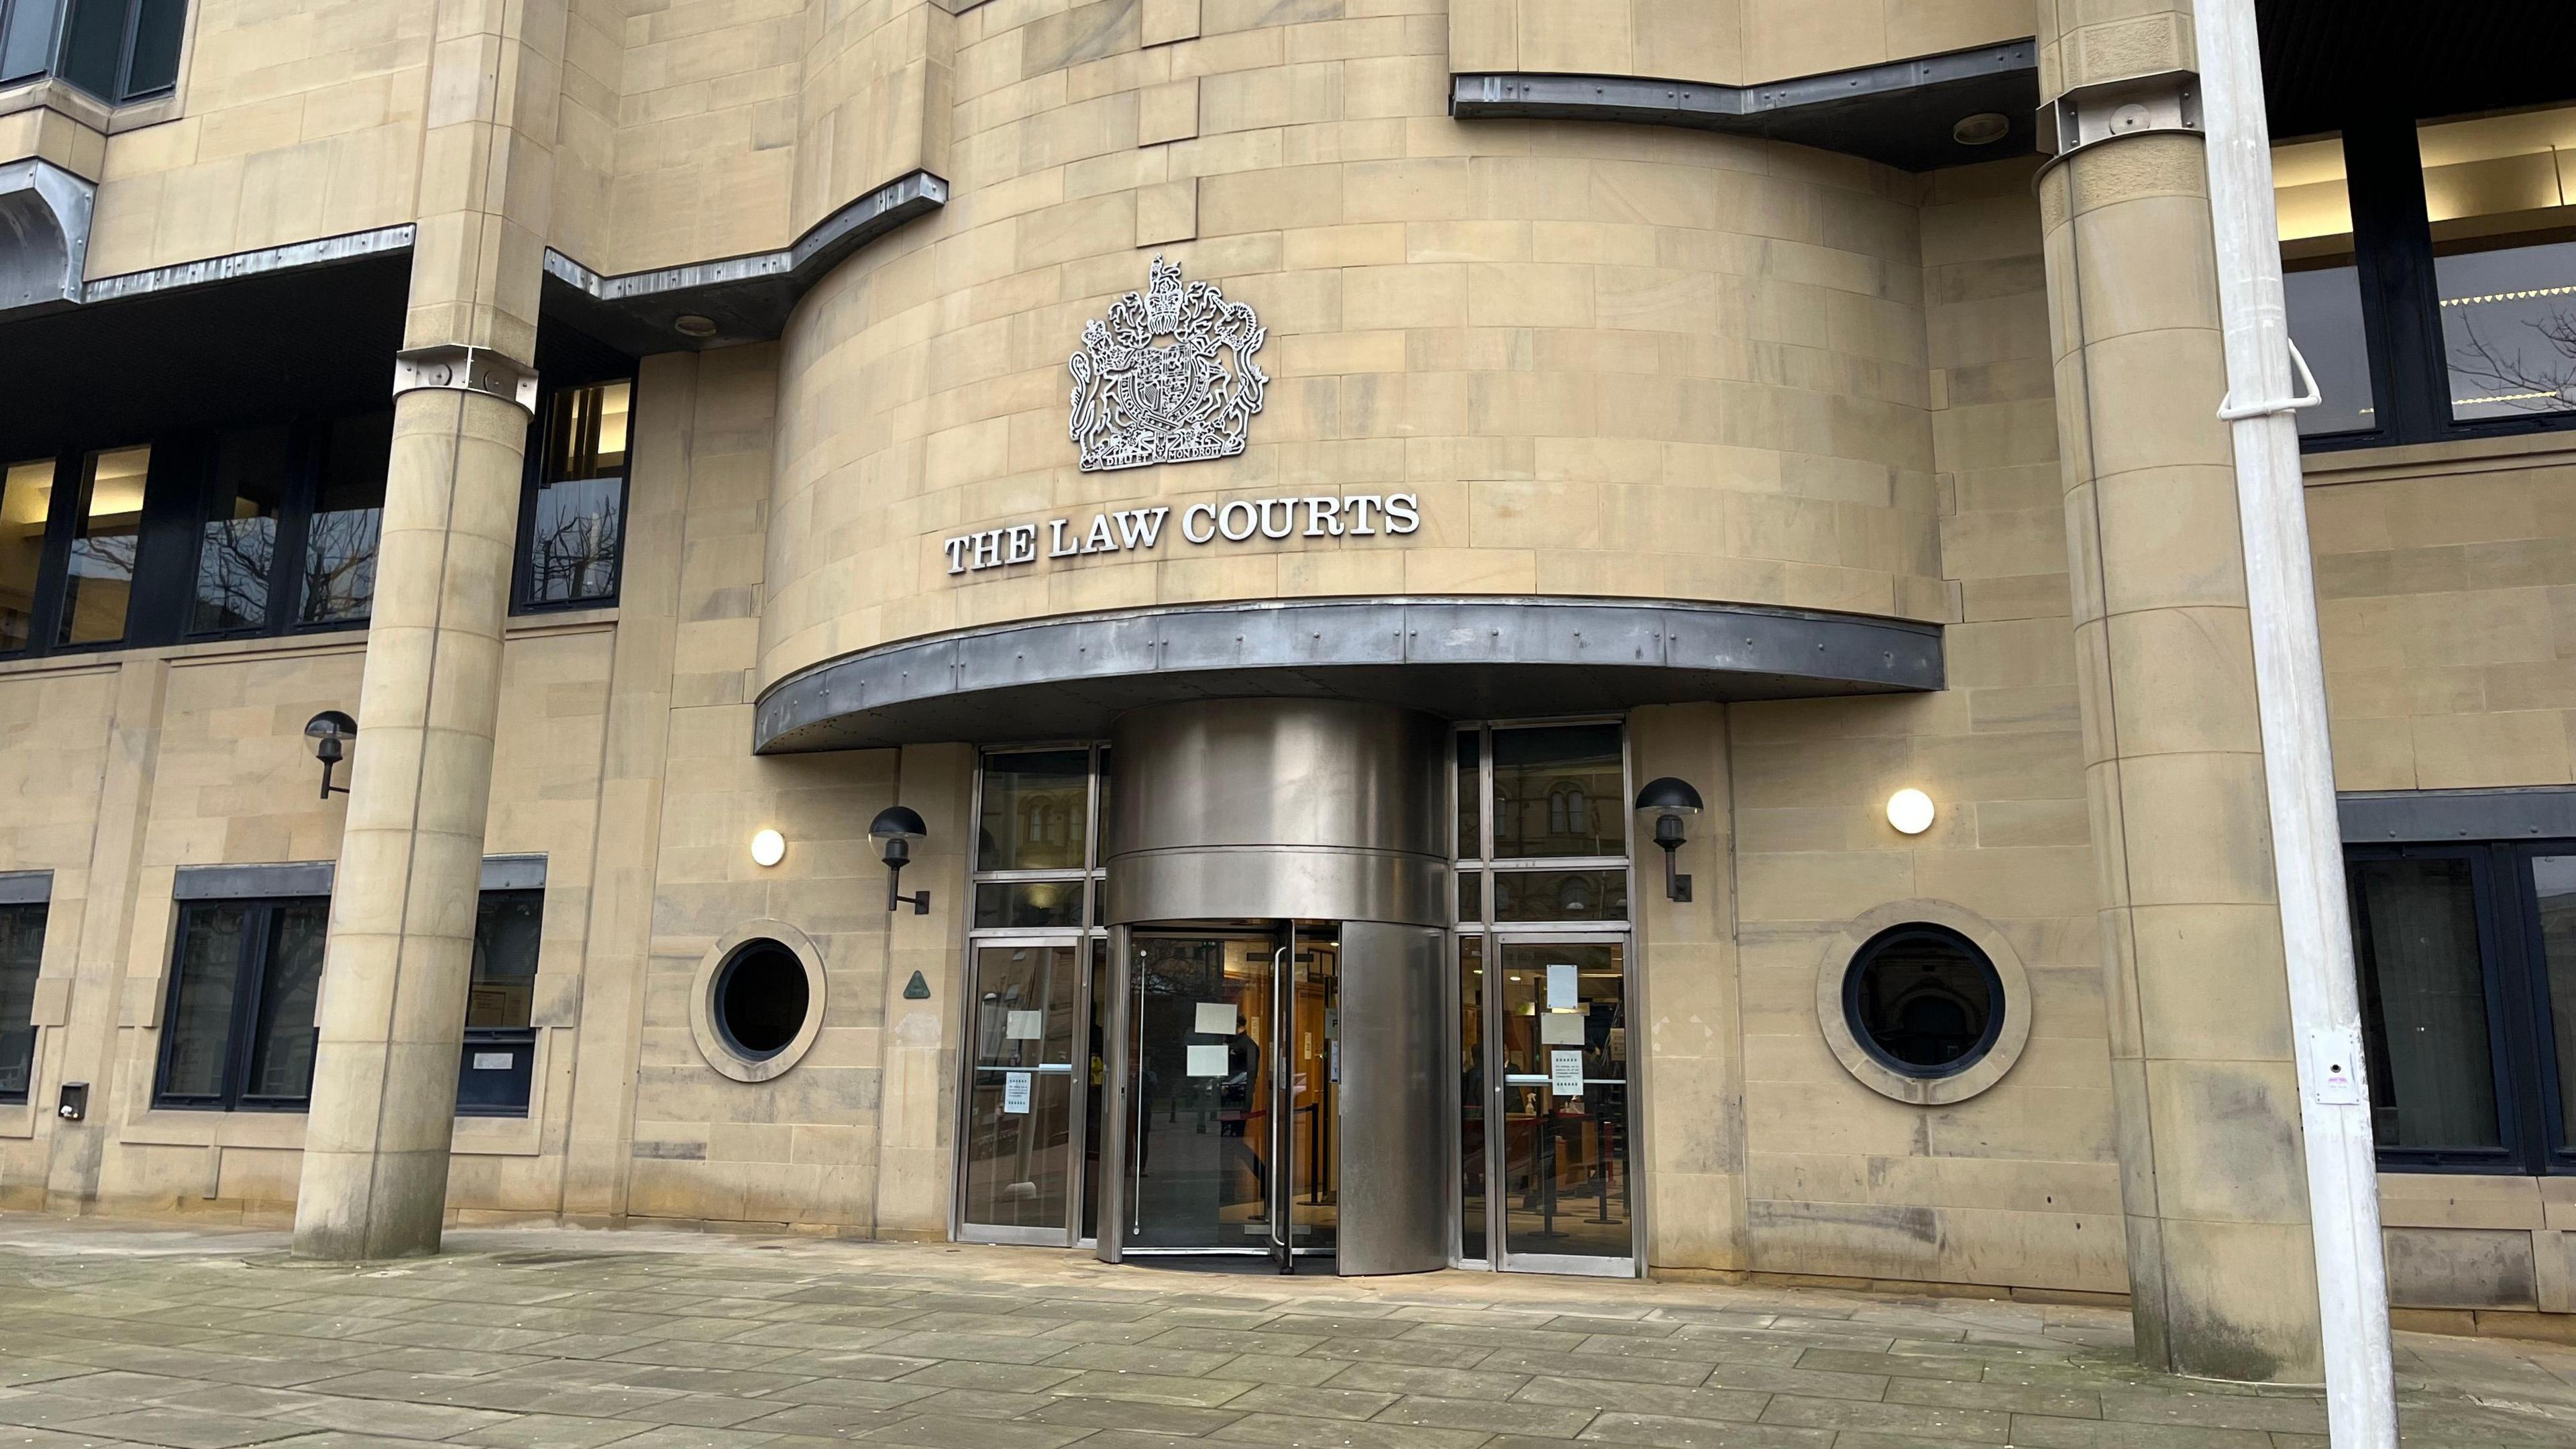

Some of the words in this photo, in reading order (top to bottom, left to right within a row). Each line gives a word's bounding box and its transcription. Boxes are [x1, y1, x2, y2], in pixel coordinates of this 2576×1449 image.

[1107, 455, 1132, 466] DIEU
[1136, 453, 1149, 463] ET
[1168, 449, 1192, 460] MON
[1192, 446, 1221, 458] DROIT
[945, 523, 1036, 575] THE
[1049, 506, 1170, 559] LAW
[1182, 493, 1419, 543] COURTS
